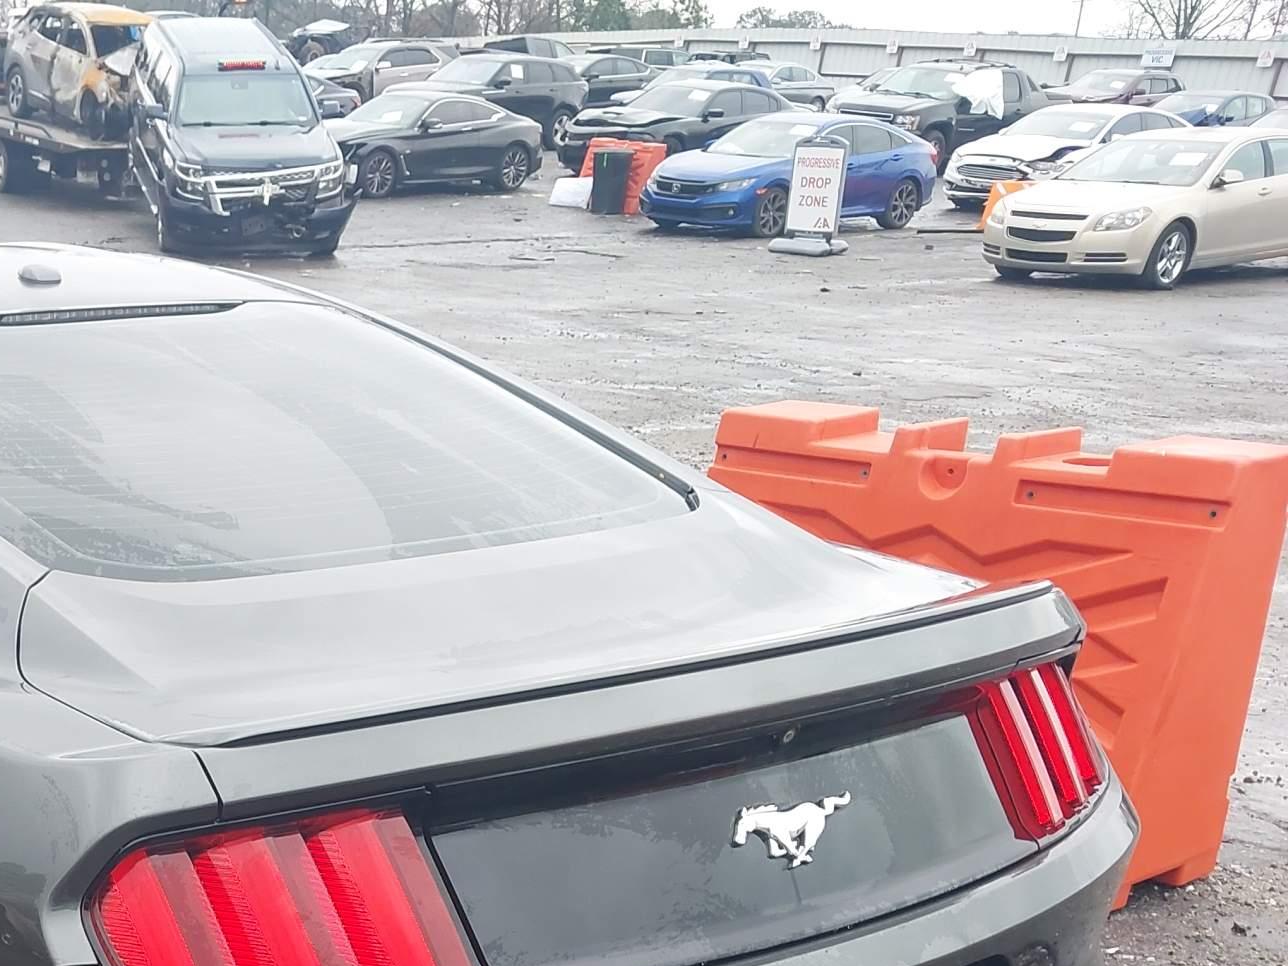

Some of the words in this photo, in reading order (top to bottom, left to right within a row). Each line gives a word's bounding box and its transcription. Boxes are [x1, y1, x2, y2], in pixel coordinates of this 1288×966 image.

[797, 157, 841, 169] PROGRESSIVE
[800, 177, 831, 189] DROP
[798, 195, 828, 207] ZONE
